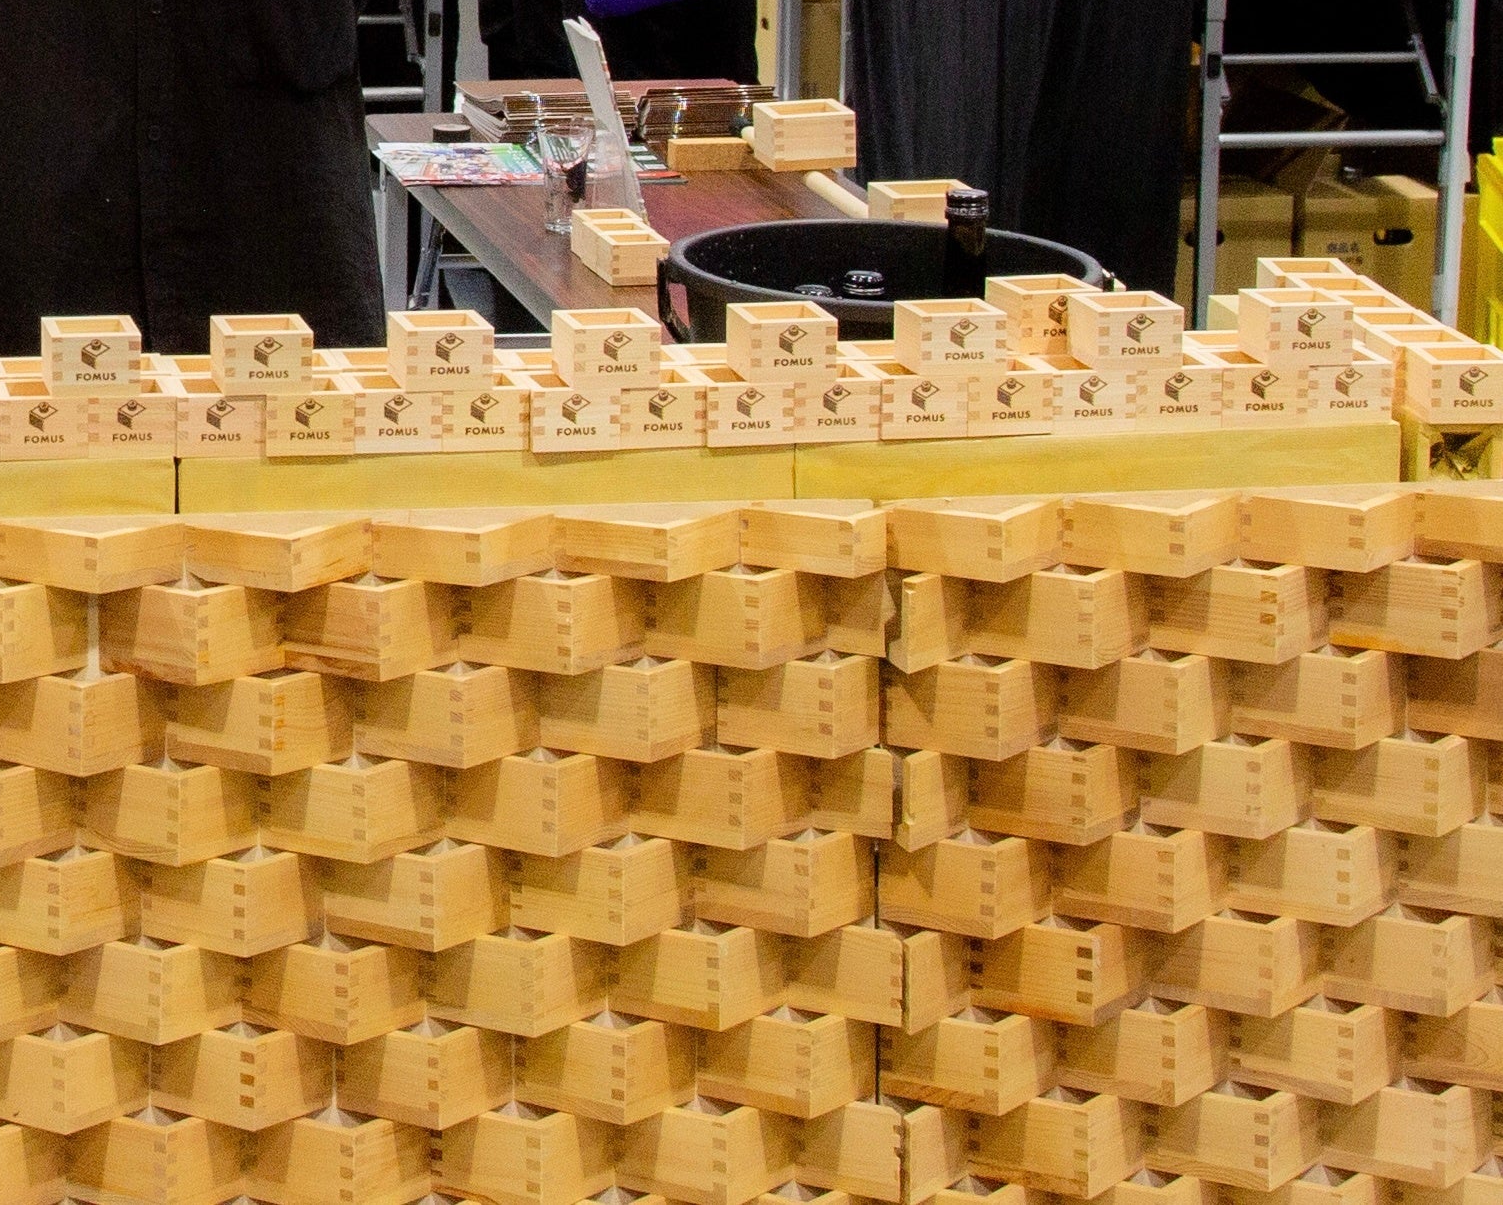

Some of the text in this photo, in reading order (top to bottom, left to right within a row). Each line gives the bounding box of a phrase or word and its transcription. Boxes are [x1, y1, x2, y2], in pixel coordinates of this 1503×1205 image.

[1043, 329, 1067, 338] FOM
[1291, 340, 1331, 350] FOMUS
[1121, 345, 1160, 356] FOMUS
[944, 351, 985, 361] FOMUS
[773, 357, 814, 367] FOMUS
[429, 366, 471, 376] FOMUS
[597, 363, 638, 374] FOMUS
[75, 372, 117, 382] FOMUS
[248, 370, 290, 379] FOMUS
[1245, 402, 1285, 412] FOMUS
[1329, 399, 1369, 409] FOMUS
[1453, 398, 1494, 408] FOMUS
[1073, 407, 1114, 418] FOMUS
[1159, 404, 1199, 414] FOMUS
[906, 413, 946, 423] FOMUS
[991, 410, 1031, 420] FOMUS
[731, 420, 771, 430] FOMUS
[817, 416, 857, 427] FOMUS
[378, 427, 419, 437] FOMUS
[464, 426, 505, 436] FOMUS
[556, 426, 597, 437] FOMUS
[643, 422, 683, 432] FOMUS
[23, 434, 65, 444] FOMUS
[111, 432, 153, 442] FOMUS
[200, 432, 242, 442] FOMUS
[289, 430, 331, 441] FOMUS
